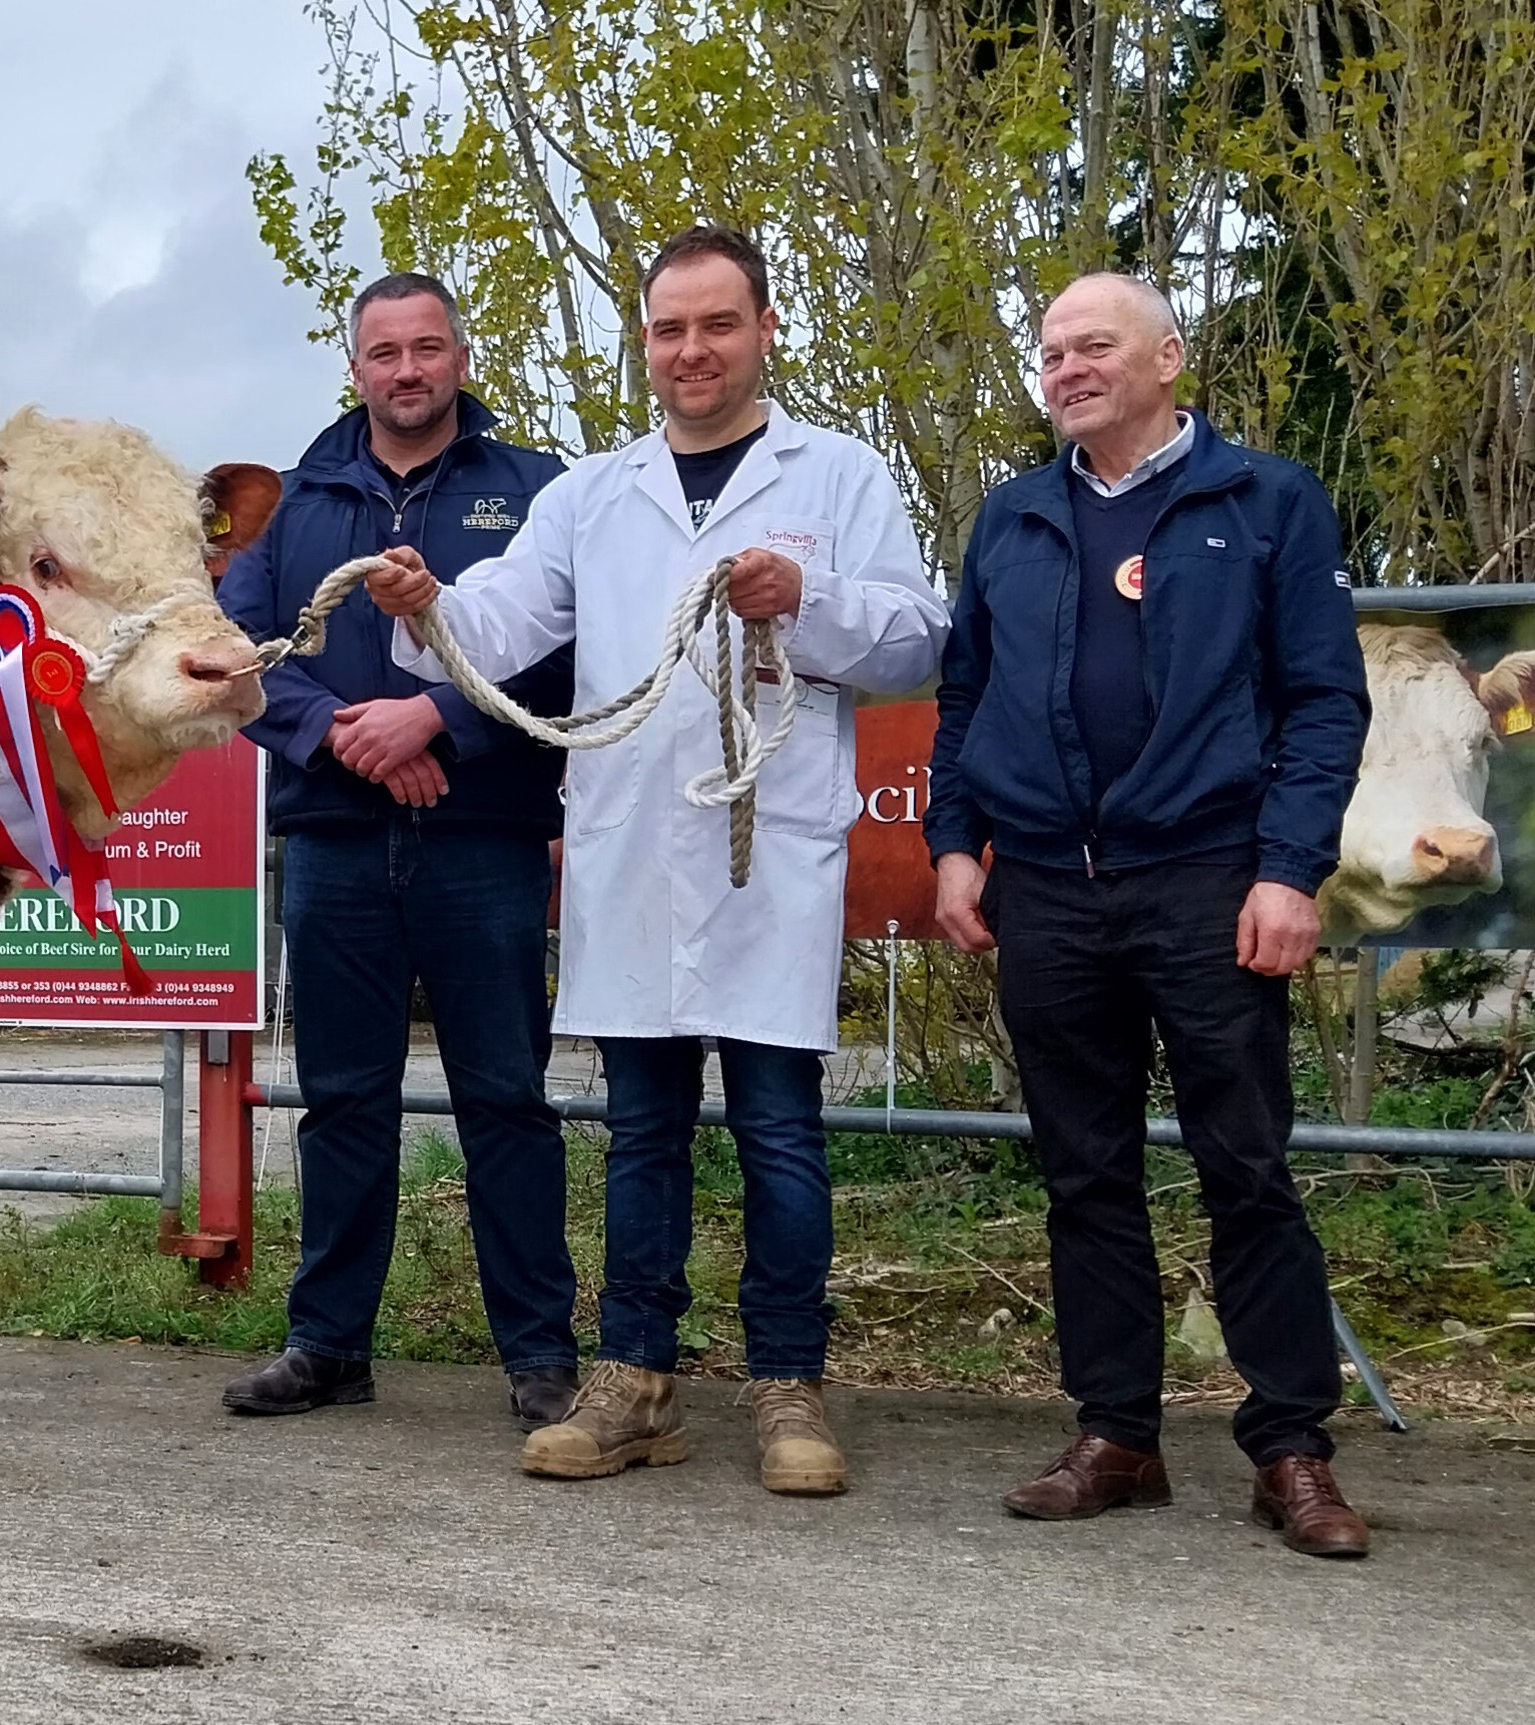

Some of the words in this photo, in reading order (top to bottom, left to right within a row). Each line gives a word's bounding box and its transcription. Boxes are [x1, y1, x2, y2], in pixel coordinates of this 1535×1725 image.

[462, 518, 519, 527] HEREFORD
[765, 530, 818, 547] Springvilla
[120, 808, 189, 829] aughter
[136, 841, 150, 858] &
[155, 841, 201, 858] Profit
[25, 942, 39, 955] of
[40, 943, 68, 956] Beef
[70, 943, 96, 956] Sire
[99, 943, 119, 956] for
[129, 946, 152, 957] our
[155, 943, 192, 960] Dairy
[196, 944, 231, 957] Herd
[21, 983, 32, 991] or
[33, 982, 50, 991] 353
[52, 981, 76, 992] (0)44
[78, 982, 118, 992] 9348862
[164, 983, 190, 994] (0)44
[192, 983, 235, 993] 9348949
[75, 994, 100, 1005] Web:
[102, 996, 219, 1007] www.irishhereford.com
